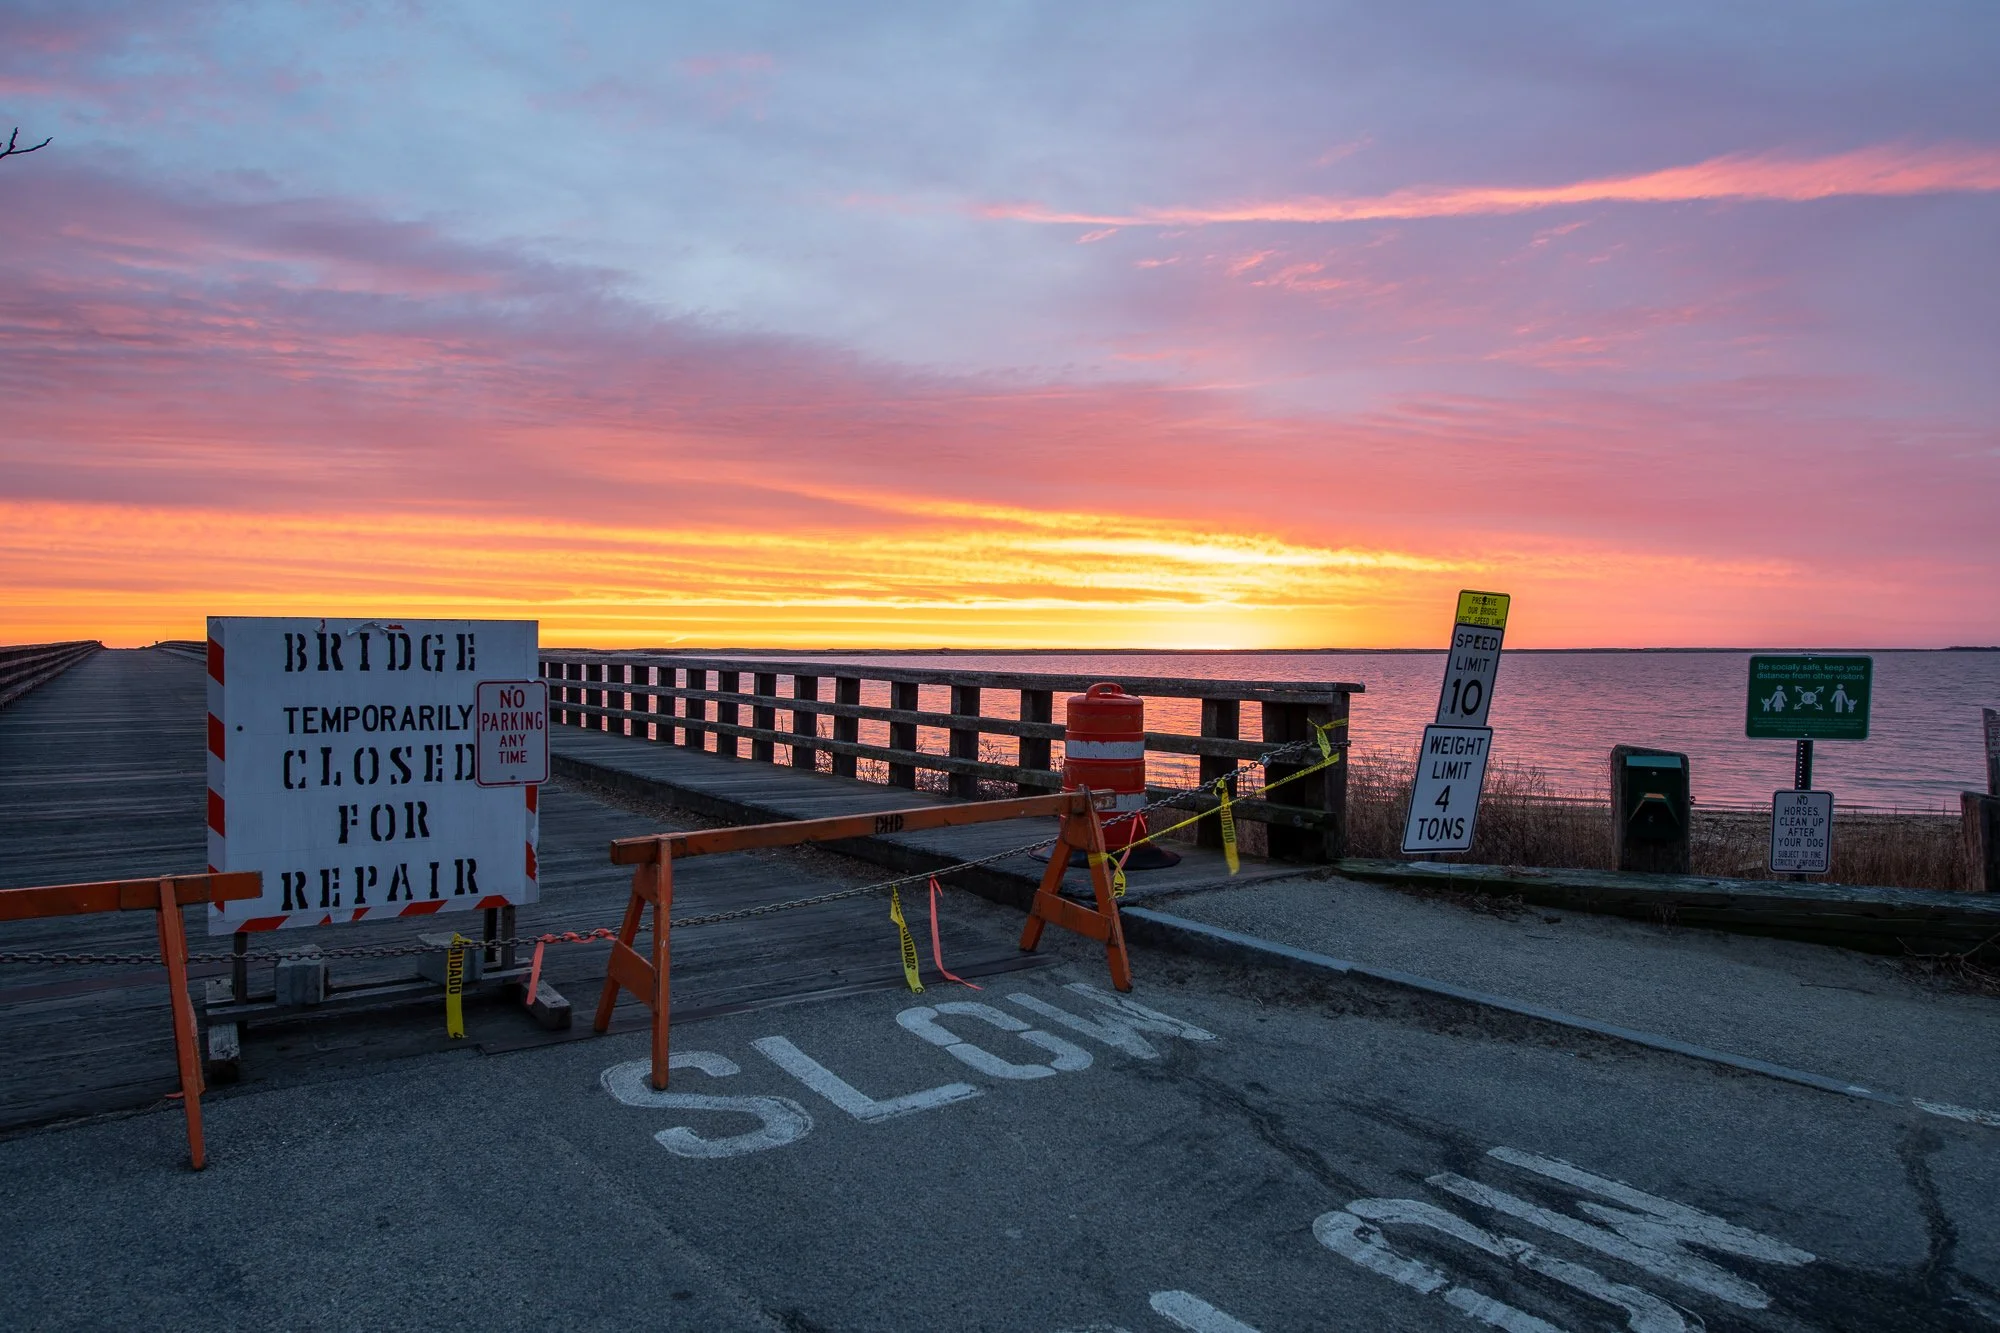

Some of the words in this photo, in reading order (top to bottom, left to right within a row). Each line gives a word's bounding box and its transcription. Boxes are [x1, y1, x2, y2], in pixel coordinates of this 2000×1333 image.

[1471, 596, 1498, 606] PREERVE
[1480, 607, 1498, 616] BRIDGE
[1455, 633, 1498, 652] SPEED
[284, 632, 476, 673] BRIDGE
[1456, 655, 1490, 673] LIMIT
[1758, 663, 1770, 671] Be
[1771, 663, 1801, 672] socially
[1824, 664, 1844, 673] keep
[1846, 665, 1865, 673] your
[1756, 672, 1790, 680] distance
[1792, 672, 1811, 680] from
[1812, 672, 1833, 680] other
[499, 689, 525, 709] NO
[1449, 678, 1483, 717] 10
[283, 703, 474, 734] TEMPORARILY
[482, 710, 543, 732] PARKING
[499, 733, 527, 748] ANY
[1430, 735, 1485, 757] WEIGHT
[283, 743, 475, 790] CLOSED
[498, 750, 528, 765] TIME
[1431, 760, 1472, 780] LIMIT
[1435, 785, 1450, 813] 4
[1796, 796, 1808, 806] NO
[338, 800, 430, 845] FOR
[1418, 817, 1465, 841] TONS
[1779, 816, 1808, 827] CLEAN
[1812, 817, 1825, 827] UP
[1787, 827, 1815, 837] AFTER
[1777, 837, 1802, 848] YOUR
[1806, 838, 1824, 848] DOG
[1775, 859, 1797, 867] STRICTLY
[1798, 859, 1825, 868] ENFORCED
[1778, 850, 1800, 859] SUBJECT
[1801, 851, 1810, 859] TO
[1810, 851, 1822, 859] FINE
[280, 858, 479, 912] REPAIR
[449, 947, 464, 994] UIDADO
[600, 981, 1220, 1160] SLOW
